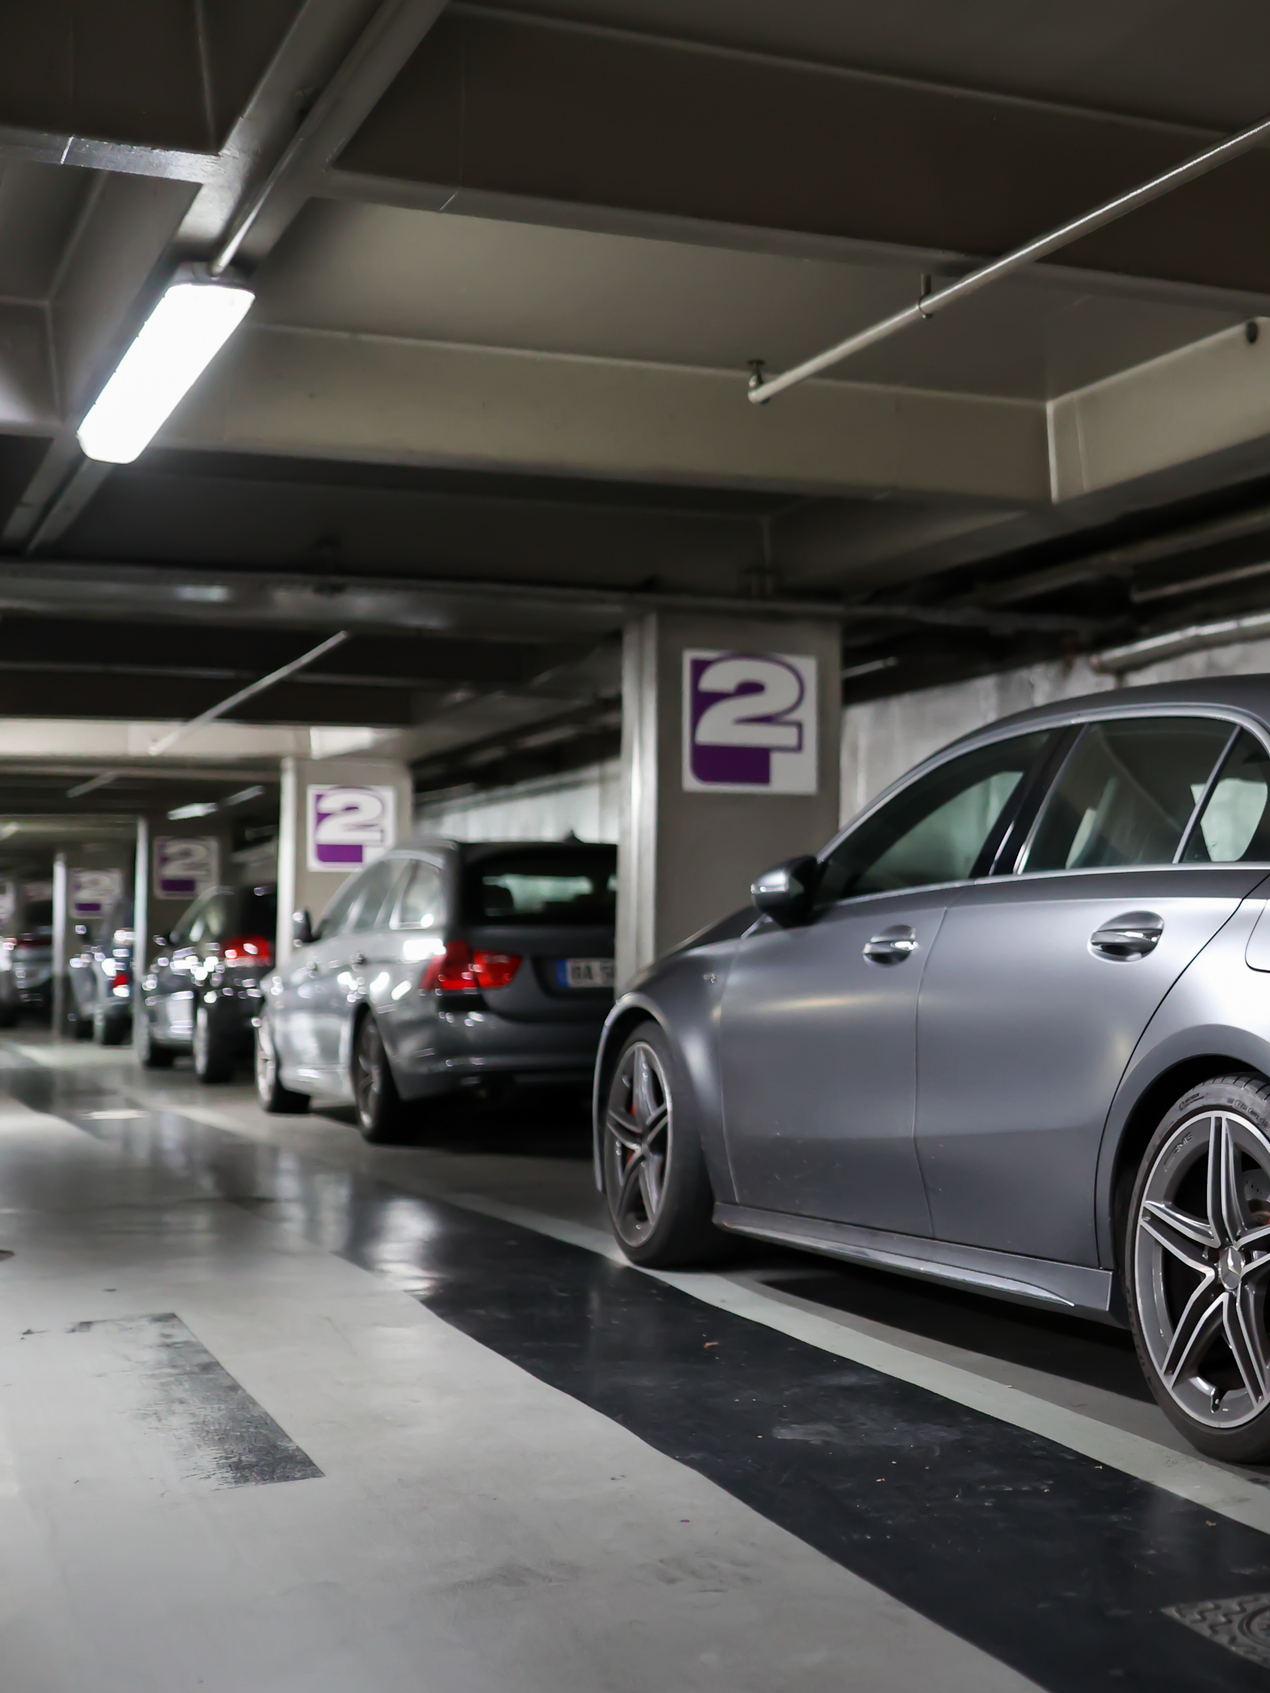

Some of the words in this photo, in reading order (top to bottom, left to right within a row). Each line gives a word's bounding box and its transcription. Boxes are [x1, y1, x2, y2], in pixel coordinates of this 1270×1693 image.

[695, 655, 803, 752] 2
[315, 789, 384, 845] 2
[160, 840, 211, 877] 2
